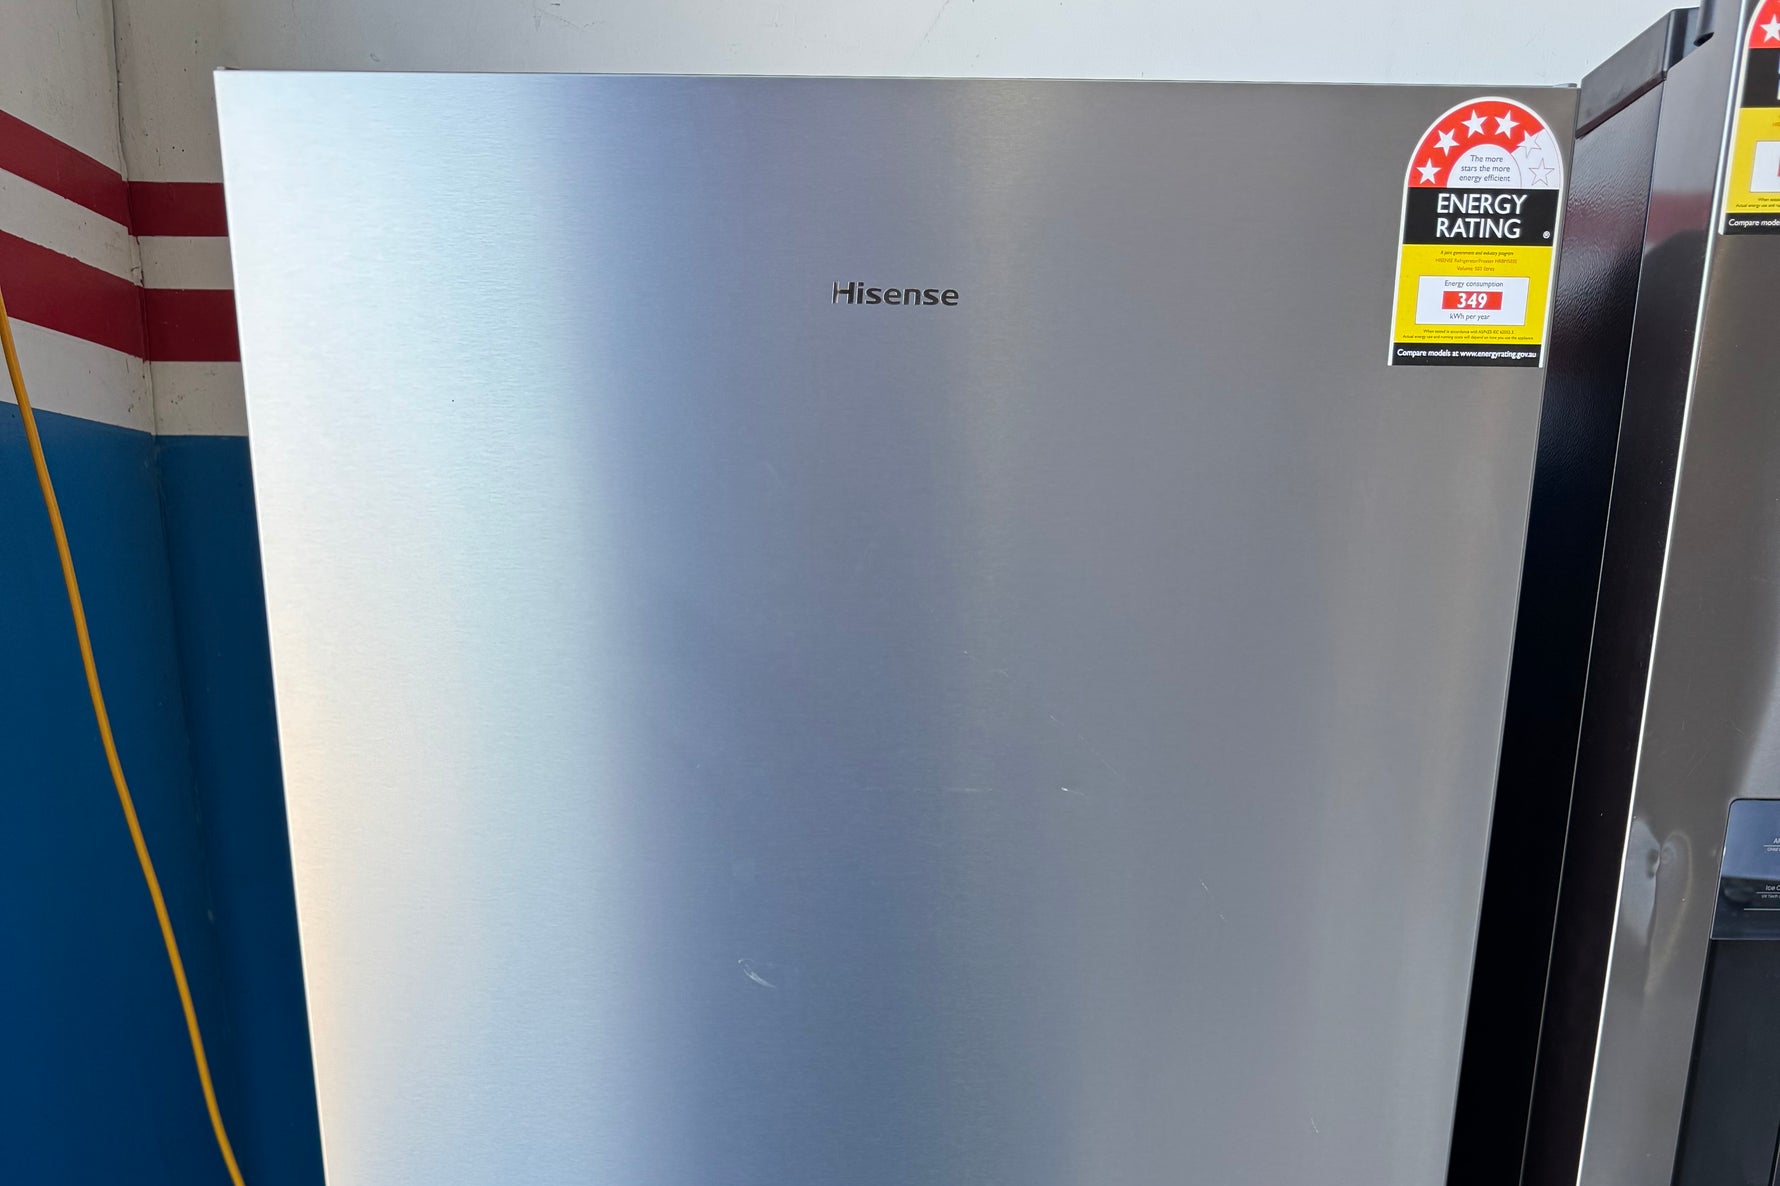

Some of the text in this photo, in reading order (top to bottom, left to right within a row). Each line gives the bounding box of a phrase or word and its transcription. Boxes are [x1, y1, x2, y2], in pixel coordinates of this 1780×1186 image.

[1470, 154, 1484, 163] The
[1479, 164, 1491, 172] the
[1459, 174, 1511, 183] energy efficient
[1437, 193, 1528, 215] ENERGY
[1436, 217, 1522, 239] RATING
[1728, 218, 1760, 228] Compare
[1444, 280, 1504, 289] Energy consumption
[832, 280, 959, 306] Hisense
[1457, 293, 1488, 309] 349
[1396, 348, 1427, 357] Compare
[1427, 349, 1451, 357] models
[1460, 350, 1537, 359] www.energyrating.gov.au
